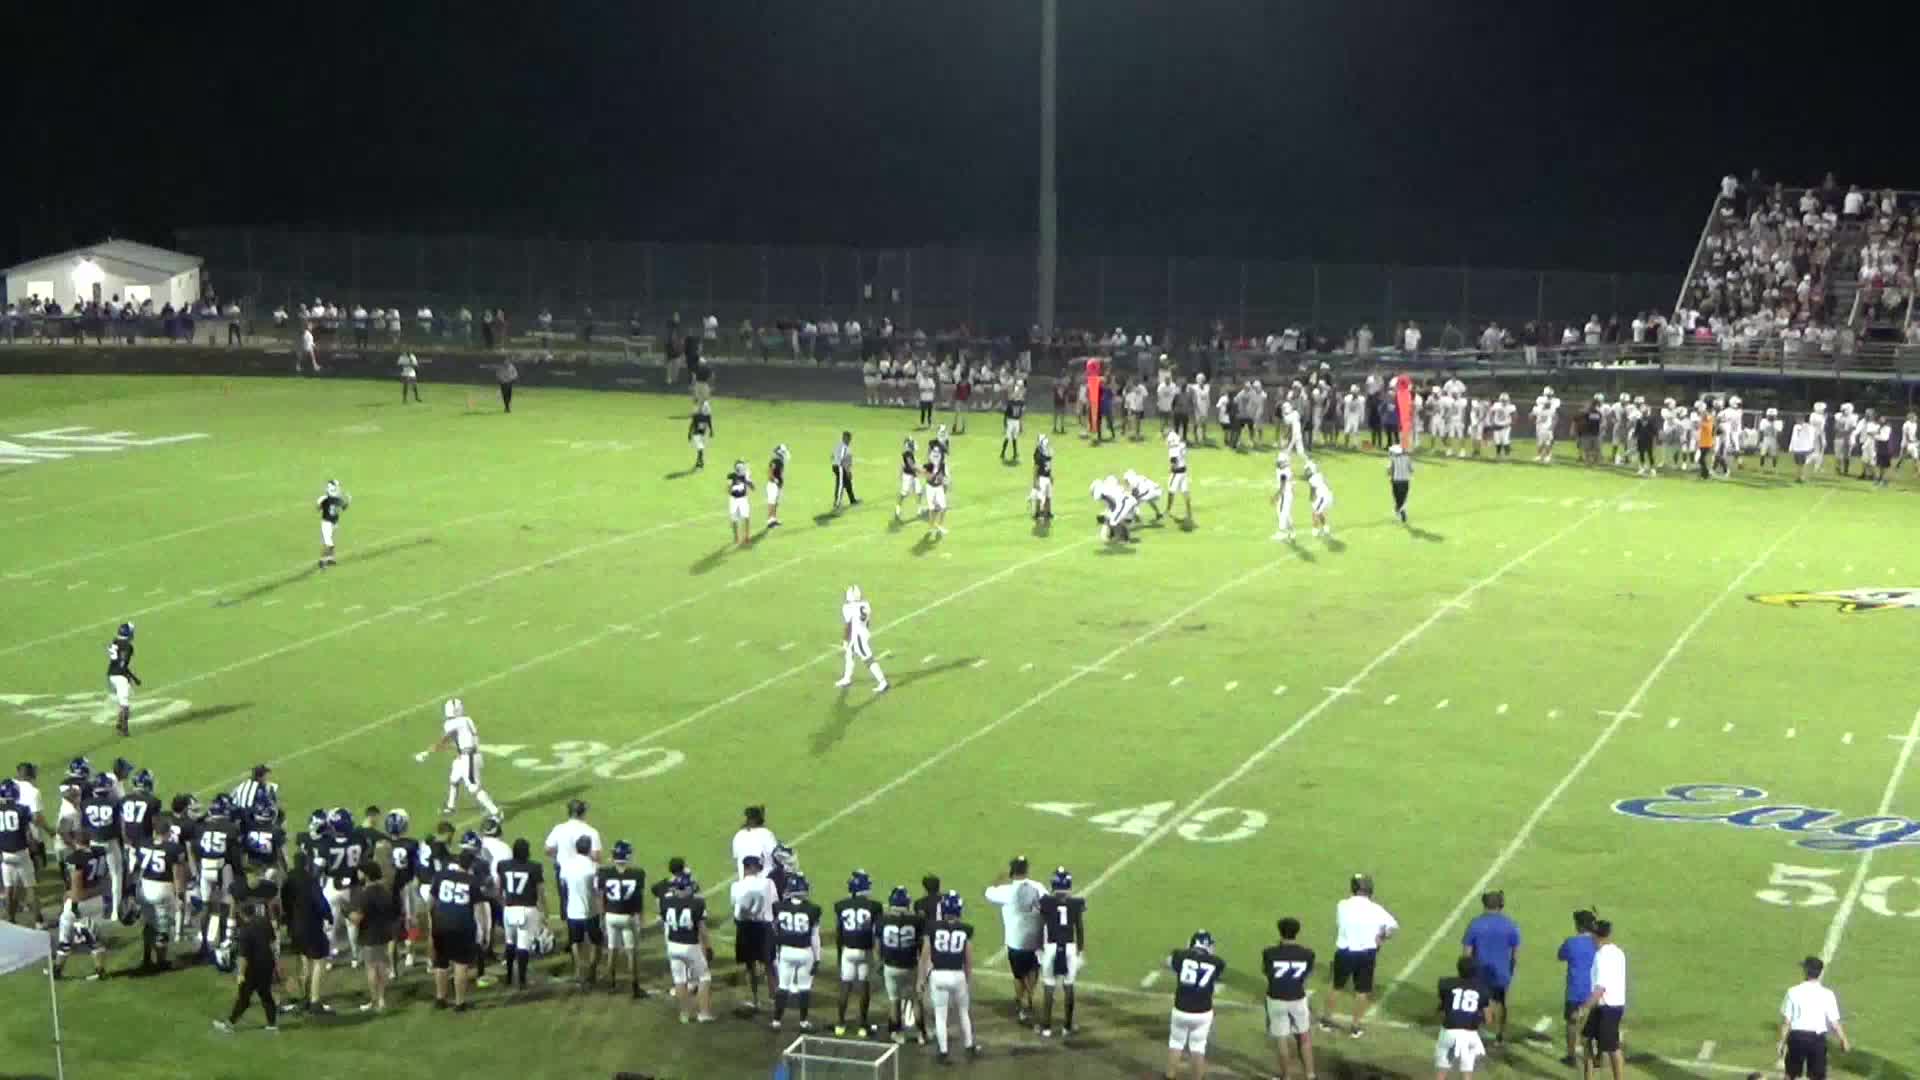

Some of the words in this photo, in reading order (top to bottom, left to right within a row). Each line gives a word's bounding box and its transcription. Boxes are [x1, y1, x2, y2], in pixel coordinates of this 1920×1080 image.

[512, 740, 686, 780] 30
[1086, 800, 1269, 842] 40
[200, 831, 227, 857] 45
[139, 846, 167, 873] 75
[439, 879, 470, 905] 65
[504, 871, 529, 895] 17
[605, 879, 637, 902] 37
[663, 907, 693, 931] 44
[1056, 905, 1069, 926] 1
[883, 924, 916, 948] 62
[1178, 958, 1216, 988] 67
[1272, 960, 1309, 979] 77
